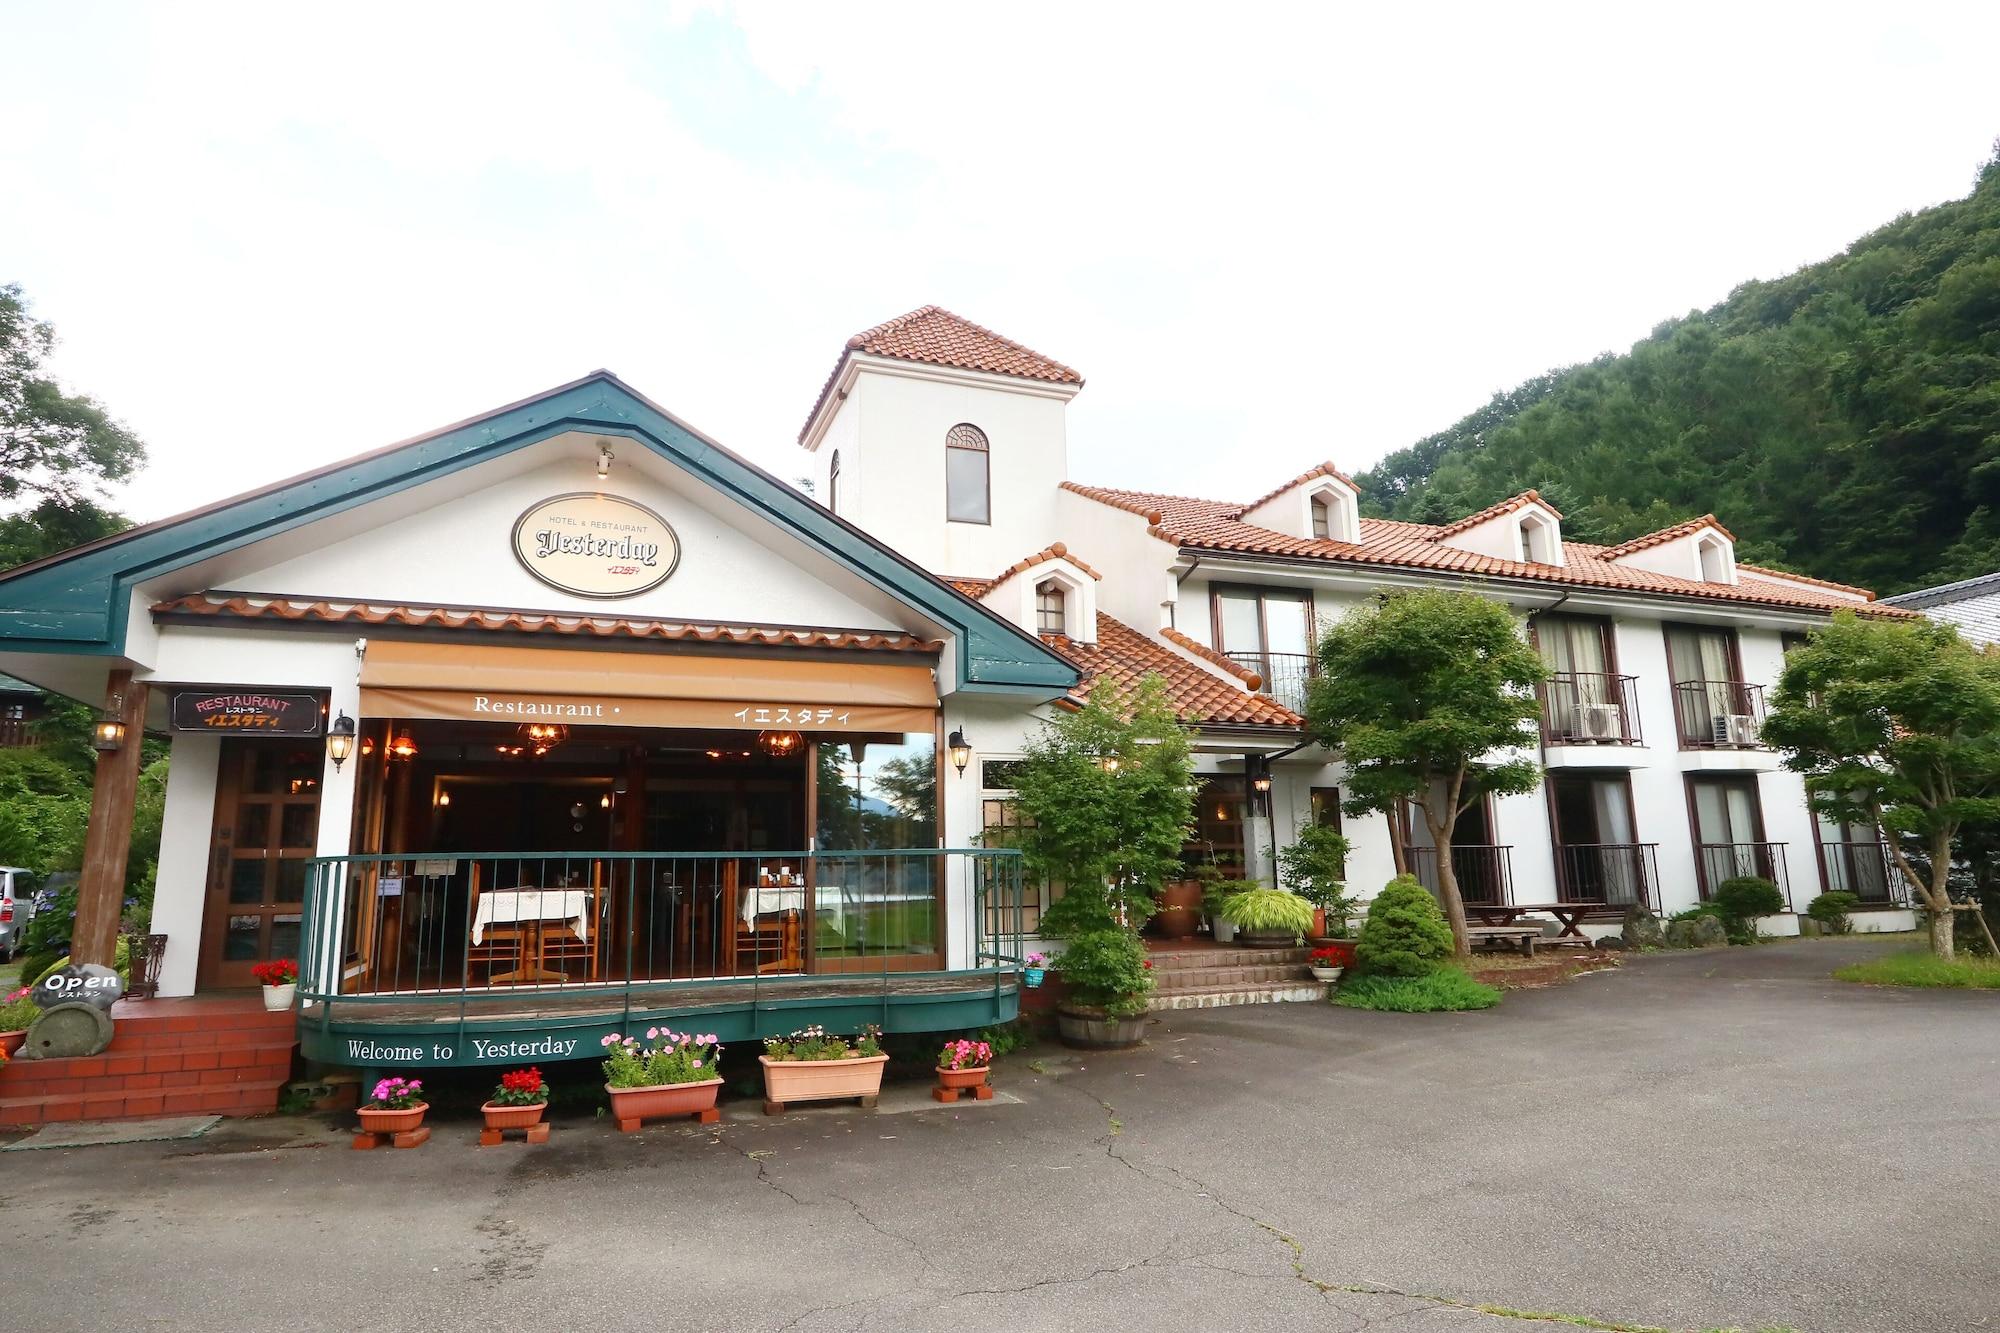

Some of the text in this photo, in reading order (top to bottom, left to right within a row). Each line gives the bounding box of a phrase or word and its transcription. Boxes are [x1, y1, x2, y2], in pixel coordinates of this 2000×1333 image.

[549, 516, 577, 526] HOTEL
[591, 521, 648, 532] RESTAURANT
[536, 529, 658, 566] Yesterday
[196, 696, 291, 712] RESTAURANT
[474, 696, 604, 717] Restaurant
[45, 974, 117, 991] Open
[348, 1036, 578, 1061] Welcome to Yesterday
